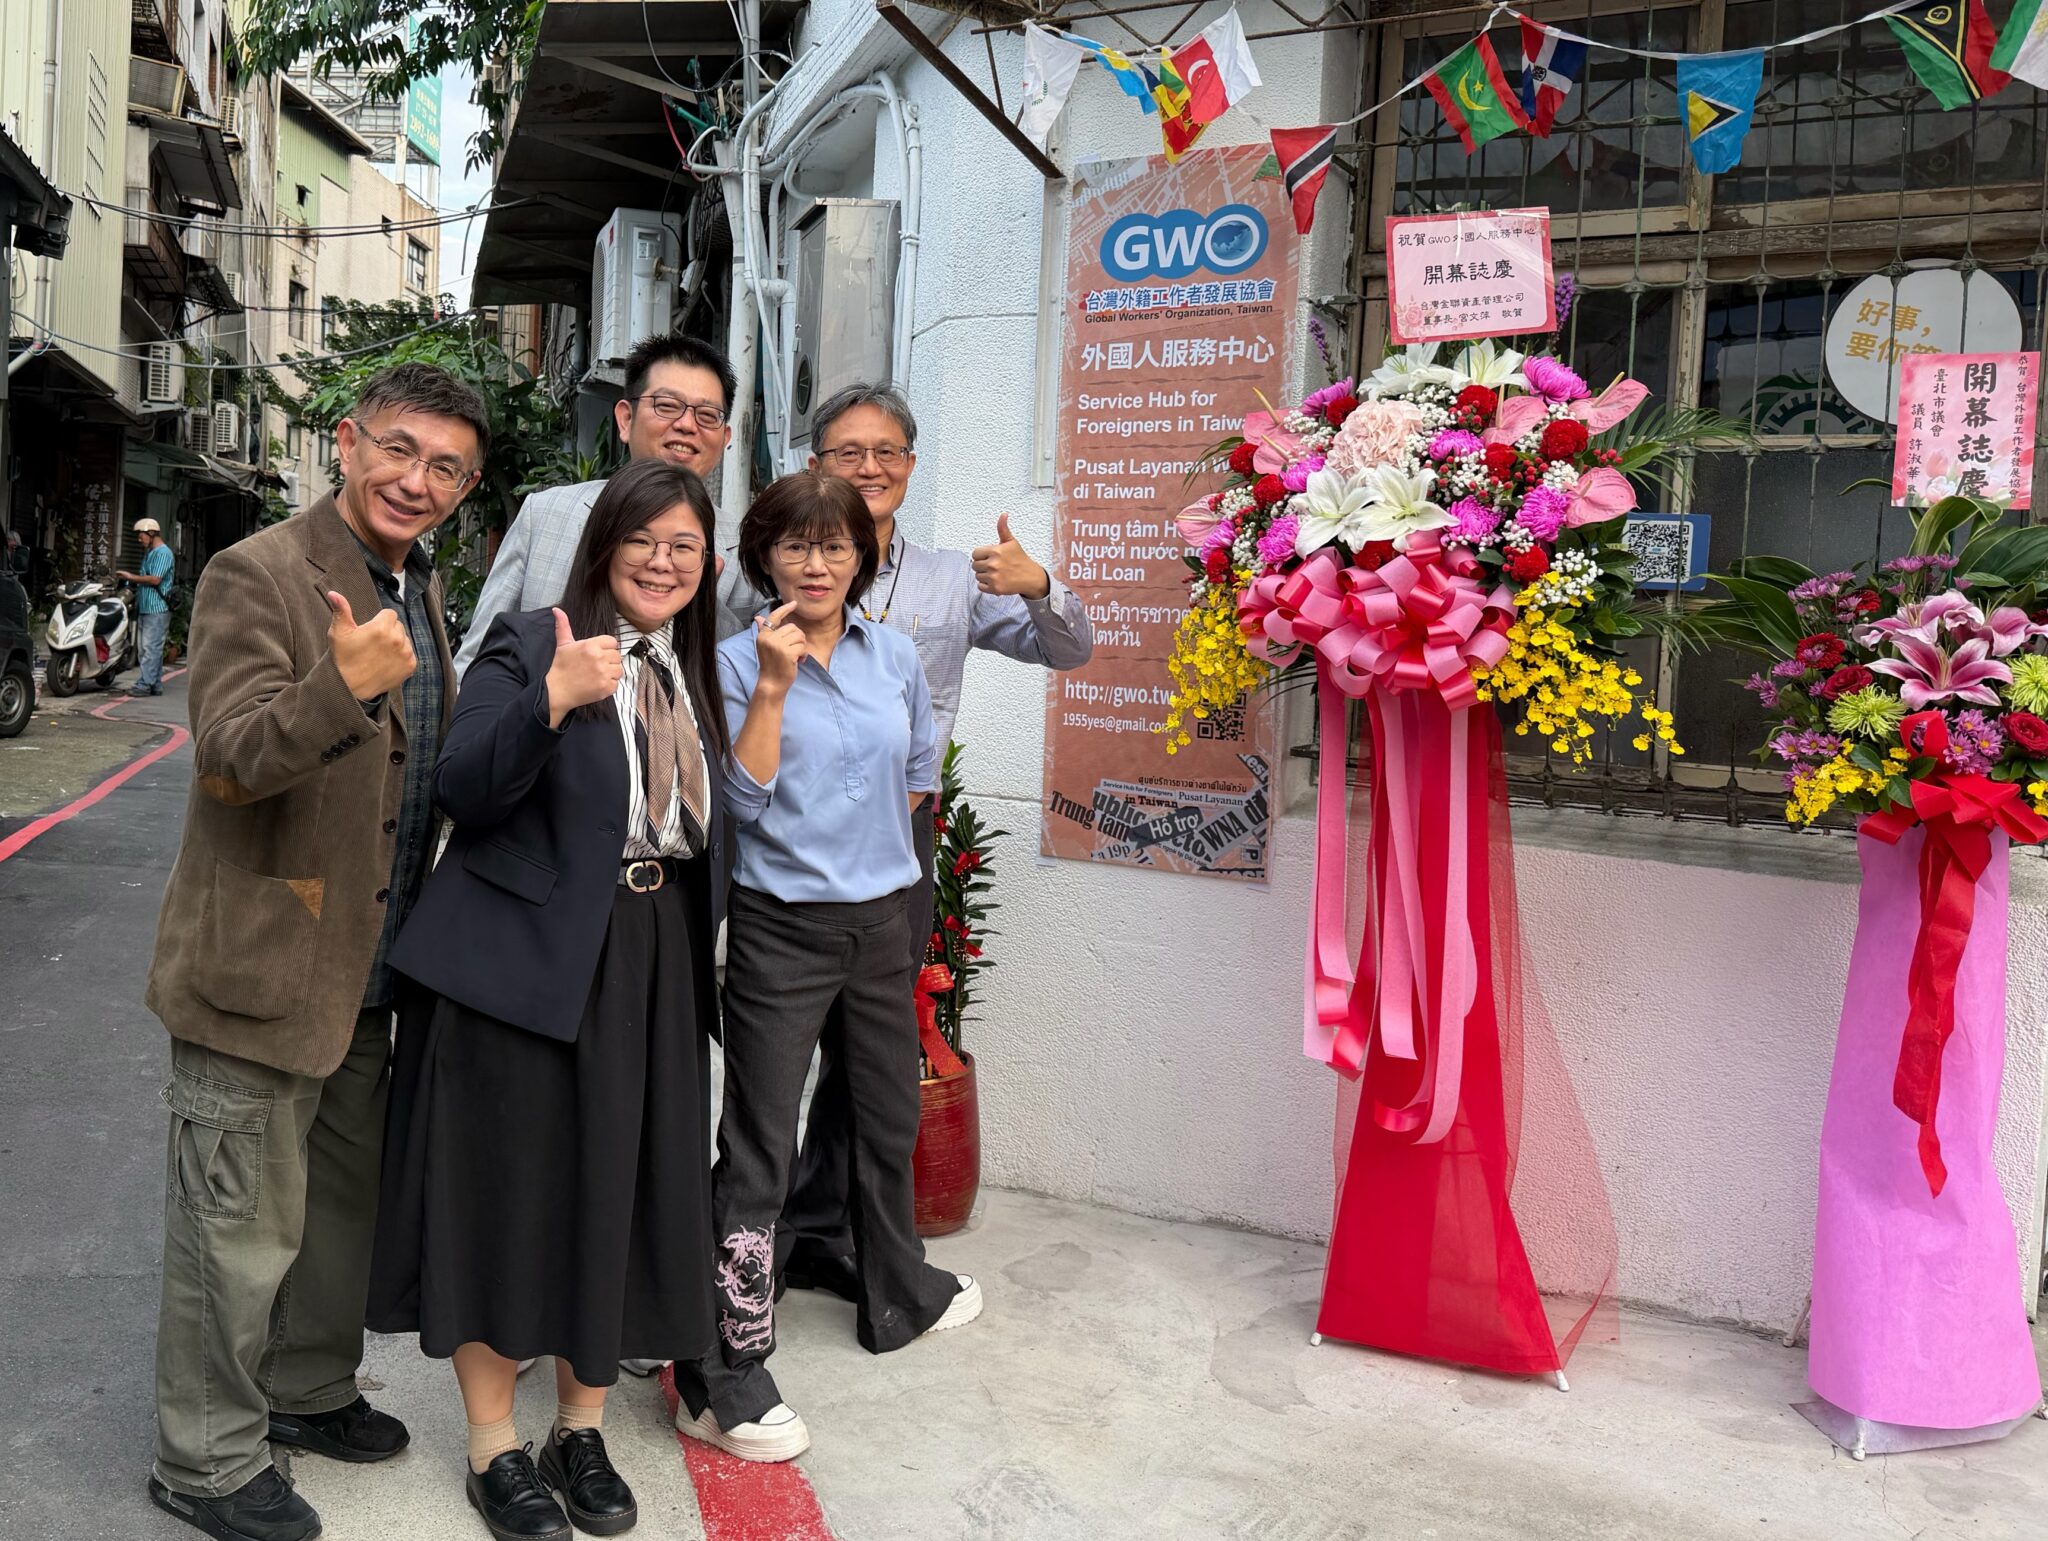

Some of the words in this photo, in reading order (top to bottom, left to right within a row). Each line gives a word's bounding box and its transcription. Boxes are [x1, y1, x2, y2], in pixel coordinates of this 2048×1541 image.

[1113, 213, 1260, 271] GWO
[1397, 233, 1426, 247] 祝賀
[1428, 235, 1451, 245] GWO
[1423, 258, 1516, 286] 開幕誌慶
[1086, 278, 1276, 312] 台灣外籍工作者發展協會
[1085, 313, 1116, 324] Global
[1119, 310, 1163, 322] Workers'
[1165, 307, 1233, 319] Organization,
[1237, 304, 1273, 314] Taiwan
[1502, 307, 1523, 319] 敬賀
[1081, 335, 1275, 372] 外國人服務中心
[2017, 355, 2028, 377] 恭賀
[1078, 394, 1143, 410] Service
[1148, 391, 1186, 408] Hub
[1191, 390, 1217, 406] for
[1930, 368, 1949, 438] 臺北市議會
[1077, 416, 1172, 438] Foreigners
[1177, 415, 1194, 432] in
[1911, 402, 1925, 430] 議員
[1956, 362, 1999, 500] 開幕誌慶
[1074, 459, 1126, 475] Pusat
[1130, 457, 1206, 481] Layanan
[1907, 438, 1923, 480] 許淑華
[1073, 484, 1089, 499] di
[1094, 483, 1155, 499] Taiwan
[1071, 519, 1121, 542] Trung
[1126, 519, 1159, 538] tâm
[1070, 541, 1125, 562] Người
[1130, 542, 1179, 560] nước
[1069, 562, 1097, 580] Đài
[1102, 563, 1145, 581] Loan
[1064, 678, 1175, 708] http://gwo.tw
[1103, 781, 1123, 790] Service
[1144, 787, 1173, 797] Foreigners
[1178, 791, 1203, 802] Pusat
[1205, 793, 1244, 806] Layanan
[1050, 790, 1096, 830] Trung
[1125, 794, 1136, 804] in
[1137, 795, 1178, 808] Taiwan
[1199, 810, 1249, 851] WNA
